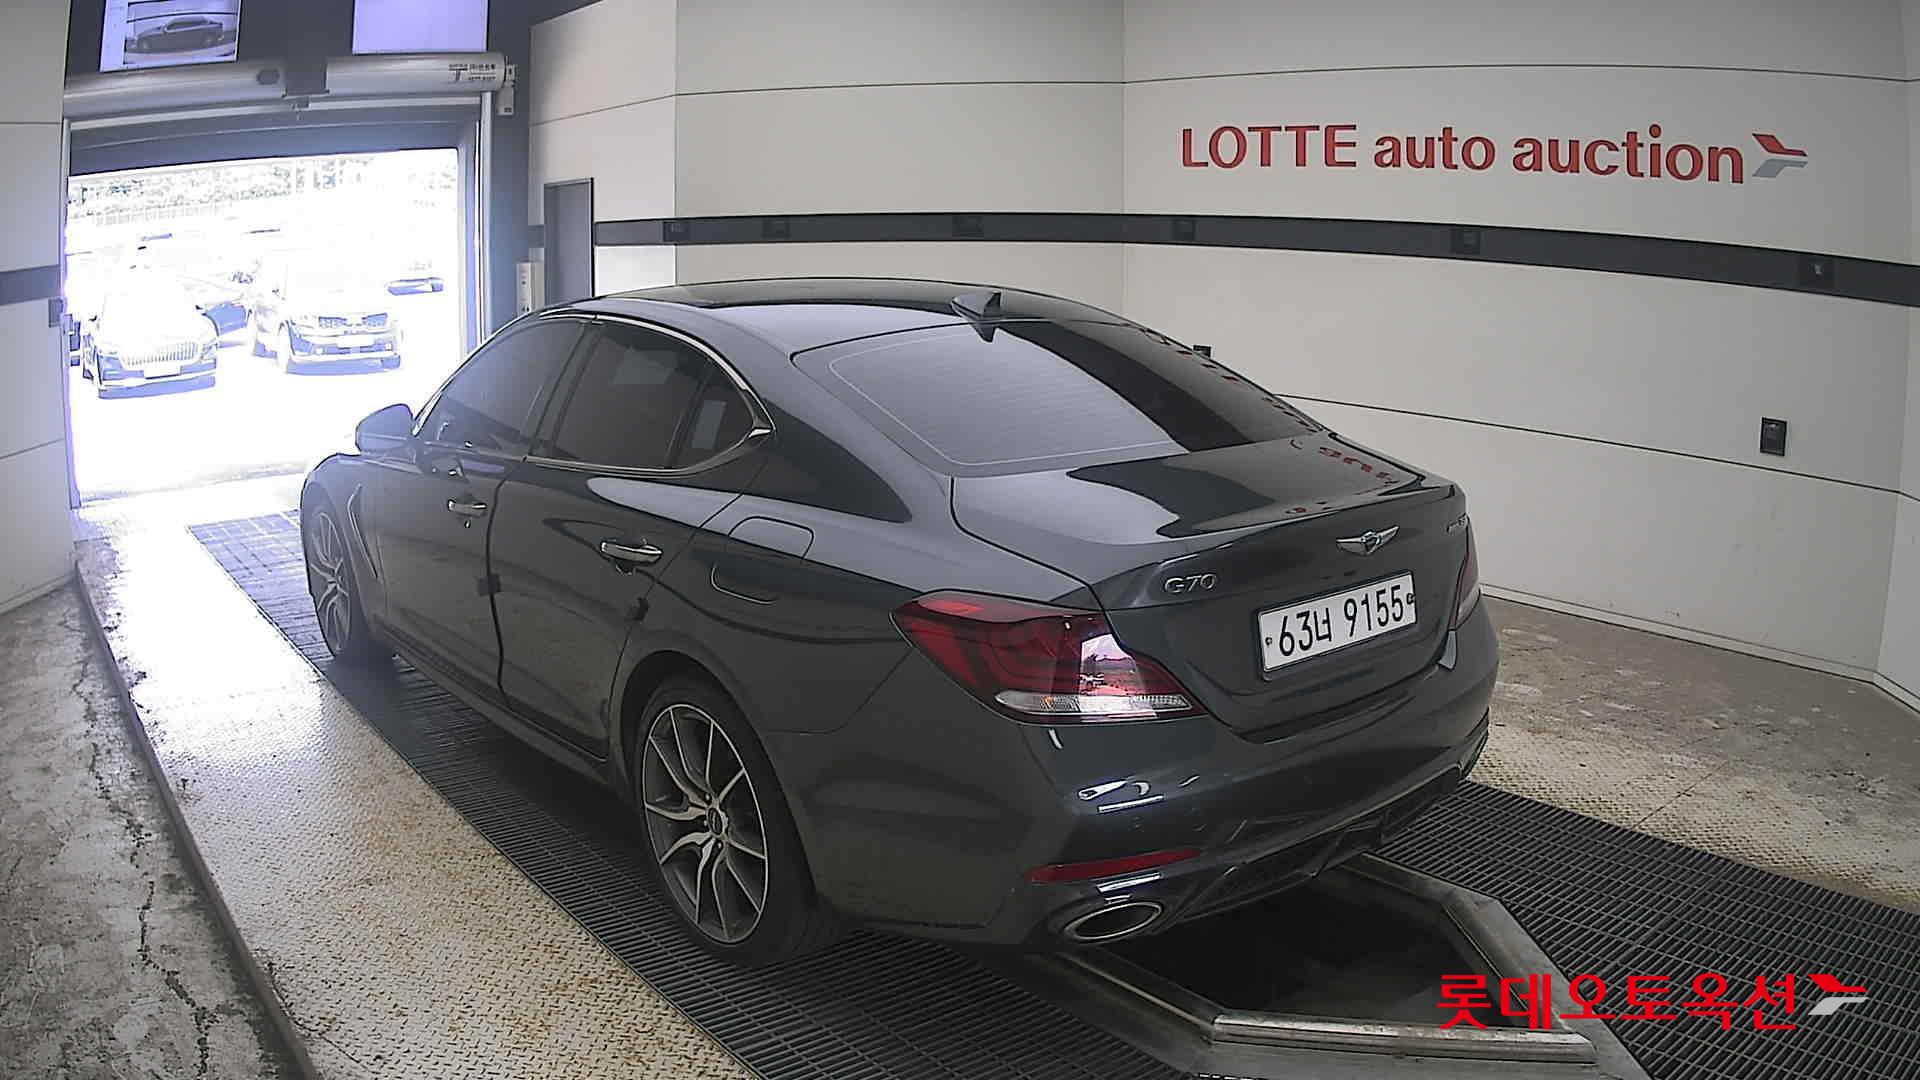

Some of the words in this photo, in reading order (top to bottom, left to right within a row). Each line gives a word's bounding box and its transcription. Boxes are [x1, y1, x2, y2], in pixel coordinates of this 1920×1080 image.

[1182, 124, 1357, 168] LOTTE
[1374, 126, 1496, 170] auto
[1512, 124, 1744, 184] auction
[1164, 573, 1216, 593] G70
[1279, 607, 1332, 656] 63너
[1344, 585, 1404, 637] 9155
